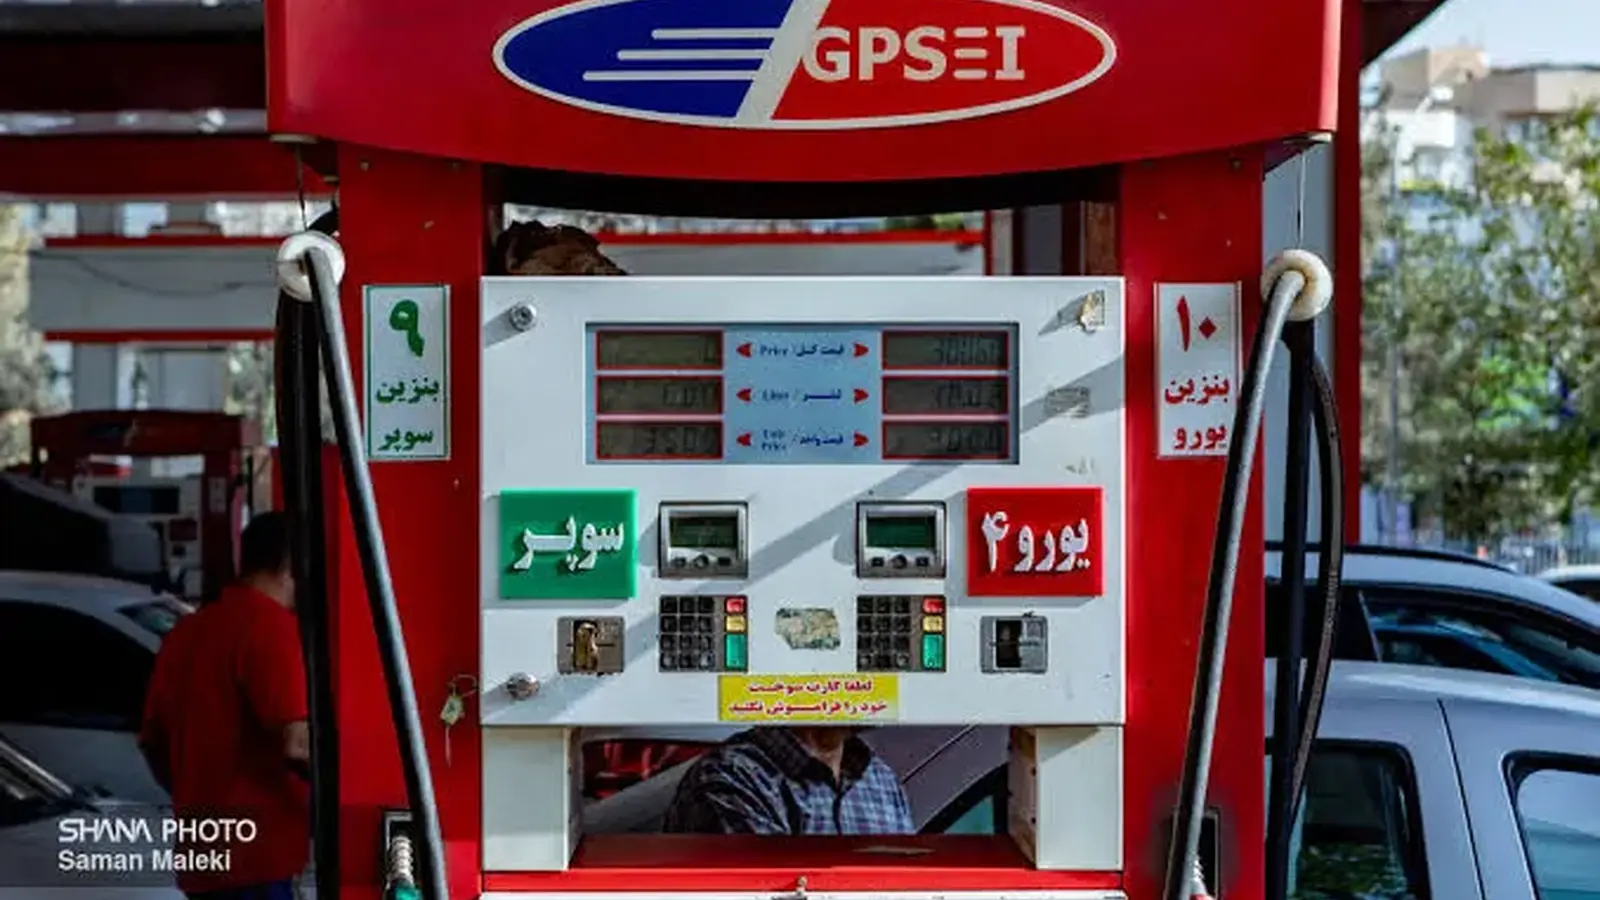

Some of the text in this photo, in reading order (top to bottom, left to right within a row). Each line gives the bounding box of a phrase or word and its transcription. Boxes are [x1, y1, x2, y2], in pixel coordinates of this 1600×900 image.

[803, 25, 1026, 82] GPSEI
[389, 299, 425, 358] ۹
[1176, 294, 1218, 352] ۱۰
[376, 377, 440, 404] بنزین
[1165, 375, 1230, 405] بنزین
[378, 428, 433, 453] سوپر
[1174, 424, 1227, 449] یورو
[513, 515, 624, 571] سوپر
[749, 681, 872, 695] لطفا کارت سوخت
[729, 700, 887, 715] خود را فراموش نکنید
